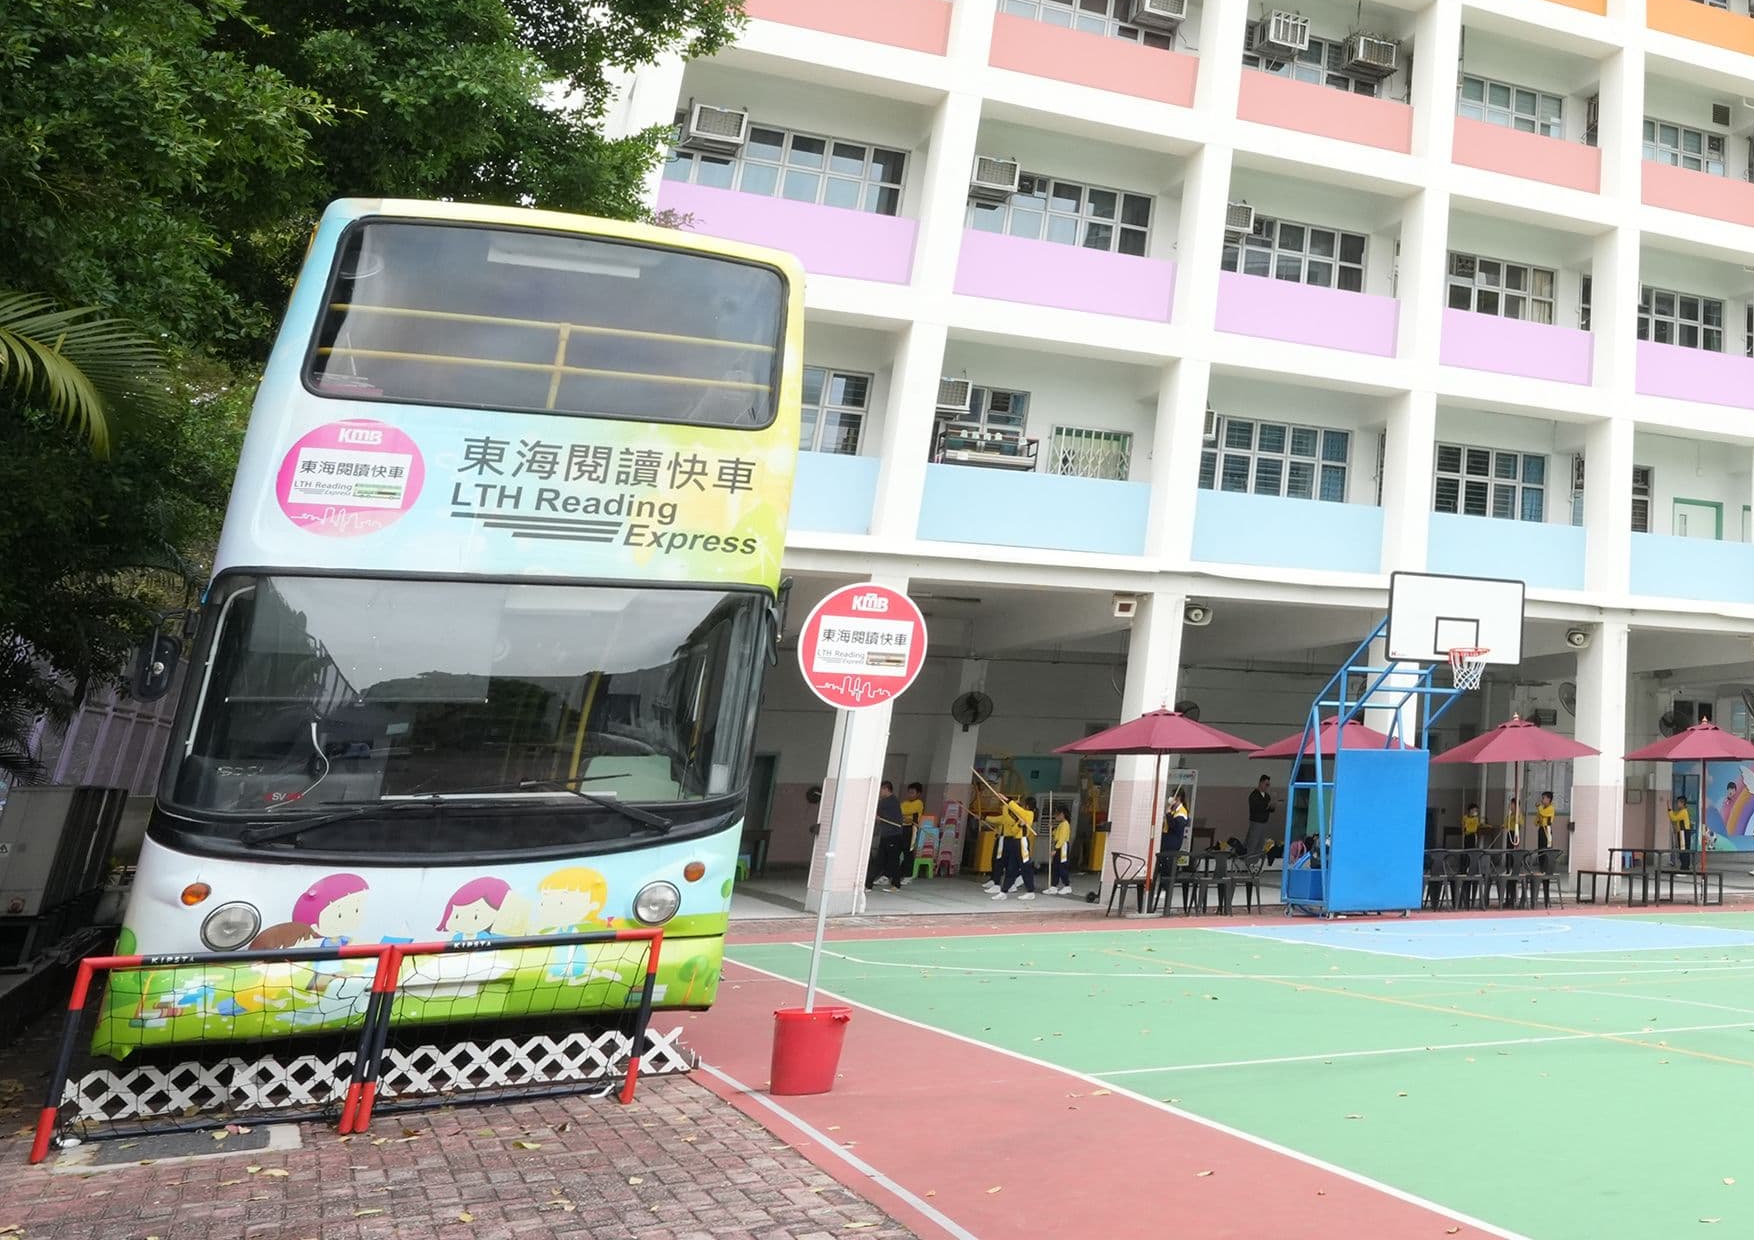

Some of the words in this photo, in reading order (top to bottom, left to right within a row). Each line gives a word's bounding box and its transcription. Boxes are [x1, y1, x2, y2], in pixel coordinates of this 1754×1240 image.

[294, 480, 312, 488] LTH
[315, 482, 353, 491] Reading
[451, 482, 523, 510] LTH
[534, 487, 678, 525] Reading
[623, 524, 757, 555] Express
[817, 649, 832, 657] LTH
[835, 650, 865, 660] Reading
